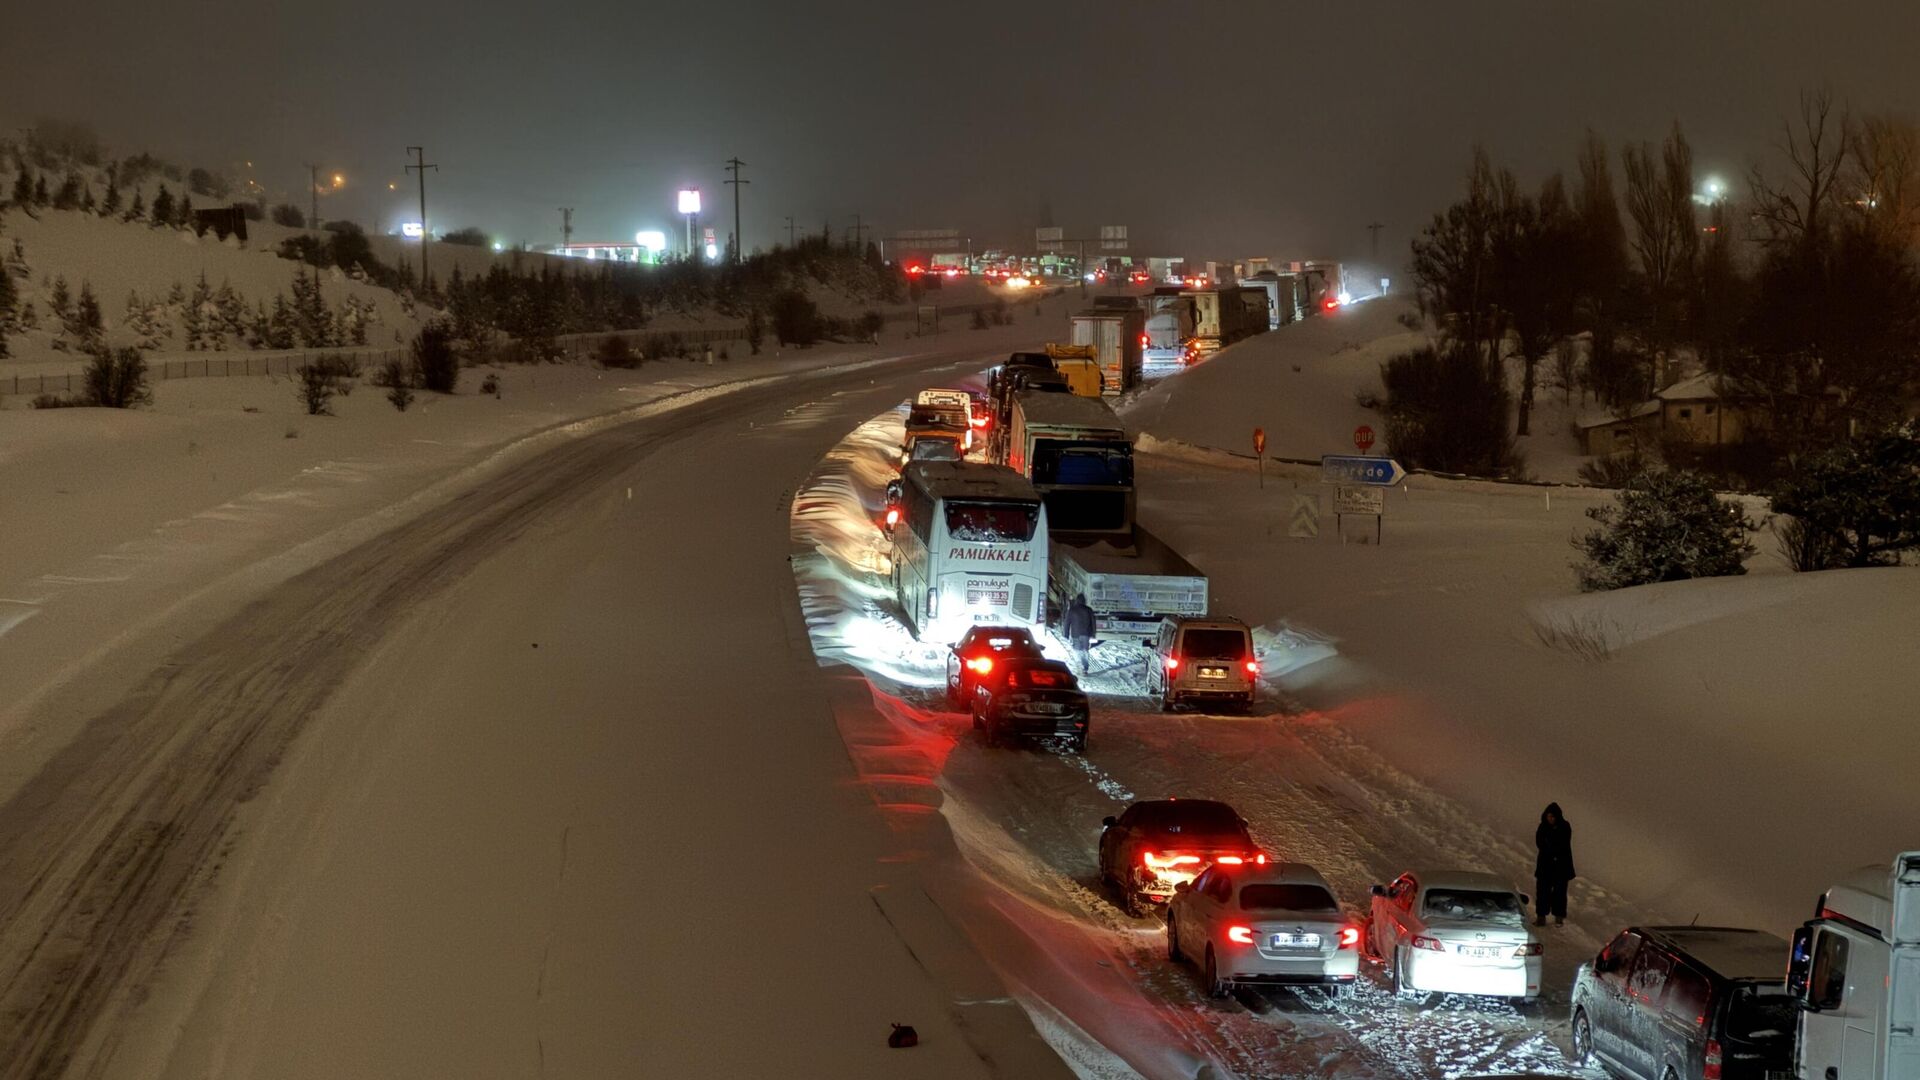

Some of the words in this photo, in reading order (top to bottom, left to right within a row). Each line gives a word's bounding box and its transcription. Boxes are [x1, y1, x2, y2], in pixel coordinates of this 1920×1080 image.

[1355, 432, 1373, 442] DUR
[949, 548, 1031, 562] PAMUKKALE
[967, 579, 1009, 590] pamukyol
